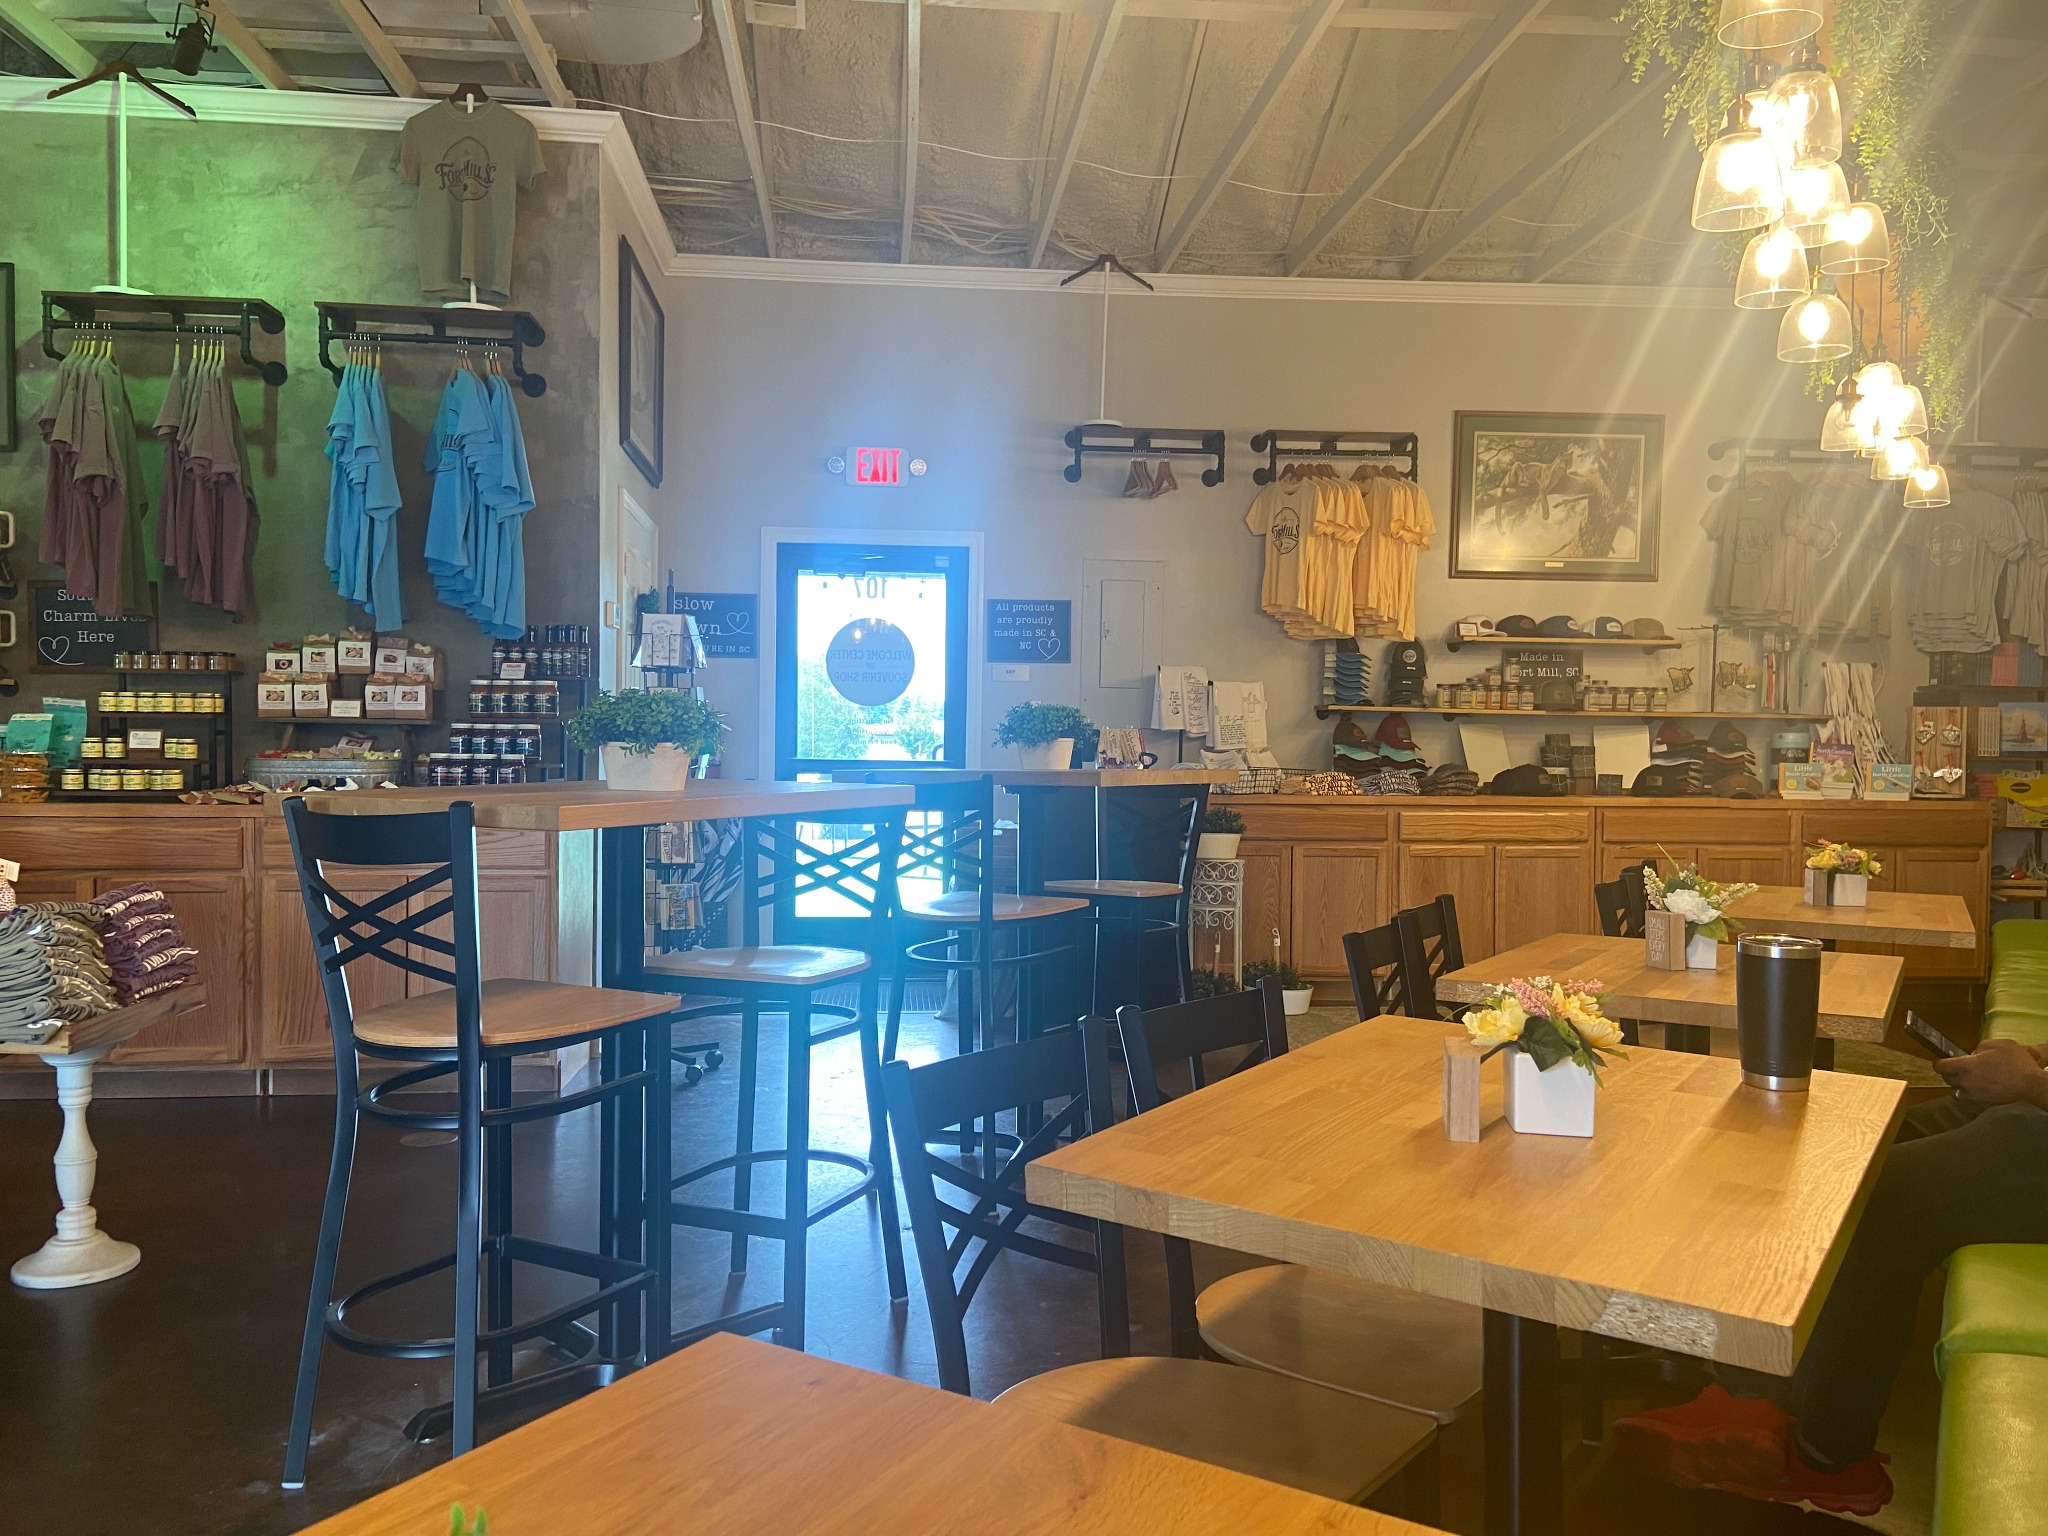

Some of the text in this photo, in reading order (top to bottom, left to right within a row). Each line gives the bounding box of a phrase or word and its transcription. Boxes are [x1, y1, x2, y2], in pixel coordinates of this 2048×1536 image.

[856, 447, 901, 484] EXIT
[674, 597, 715, 611] slow
[996, 603, 1055, 613] All products
[43, 609, 98, 622] Charm
[996, 616, 1053, 625] are proudly
[697, 623, 721, 635] wn
[993, 629, 1057, 637] made in SC &
[77, 630, 115, 643] Here
[725, 645, 736, 653] IN
[1019, 641, 1032, 650] NC
[1520, 651, 1564, 662] Made in
[1537, 667, 1562, 679] Mill,
[1565, 667, 1580, 677] SC
[1794, 764, 1813, 772] Little
[1881, 765, 1901, 773] Little
[2004, 771, 2039, 779] PLAY
[1648, 916, 1666, 930] SMALL
[1649, 928, 1665, 941] STEPS
[1648, 939, 1665, 952] EVERY
[1651, 951, 1663, 962] DAY
